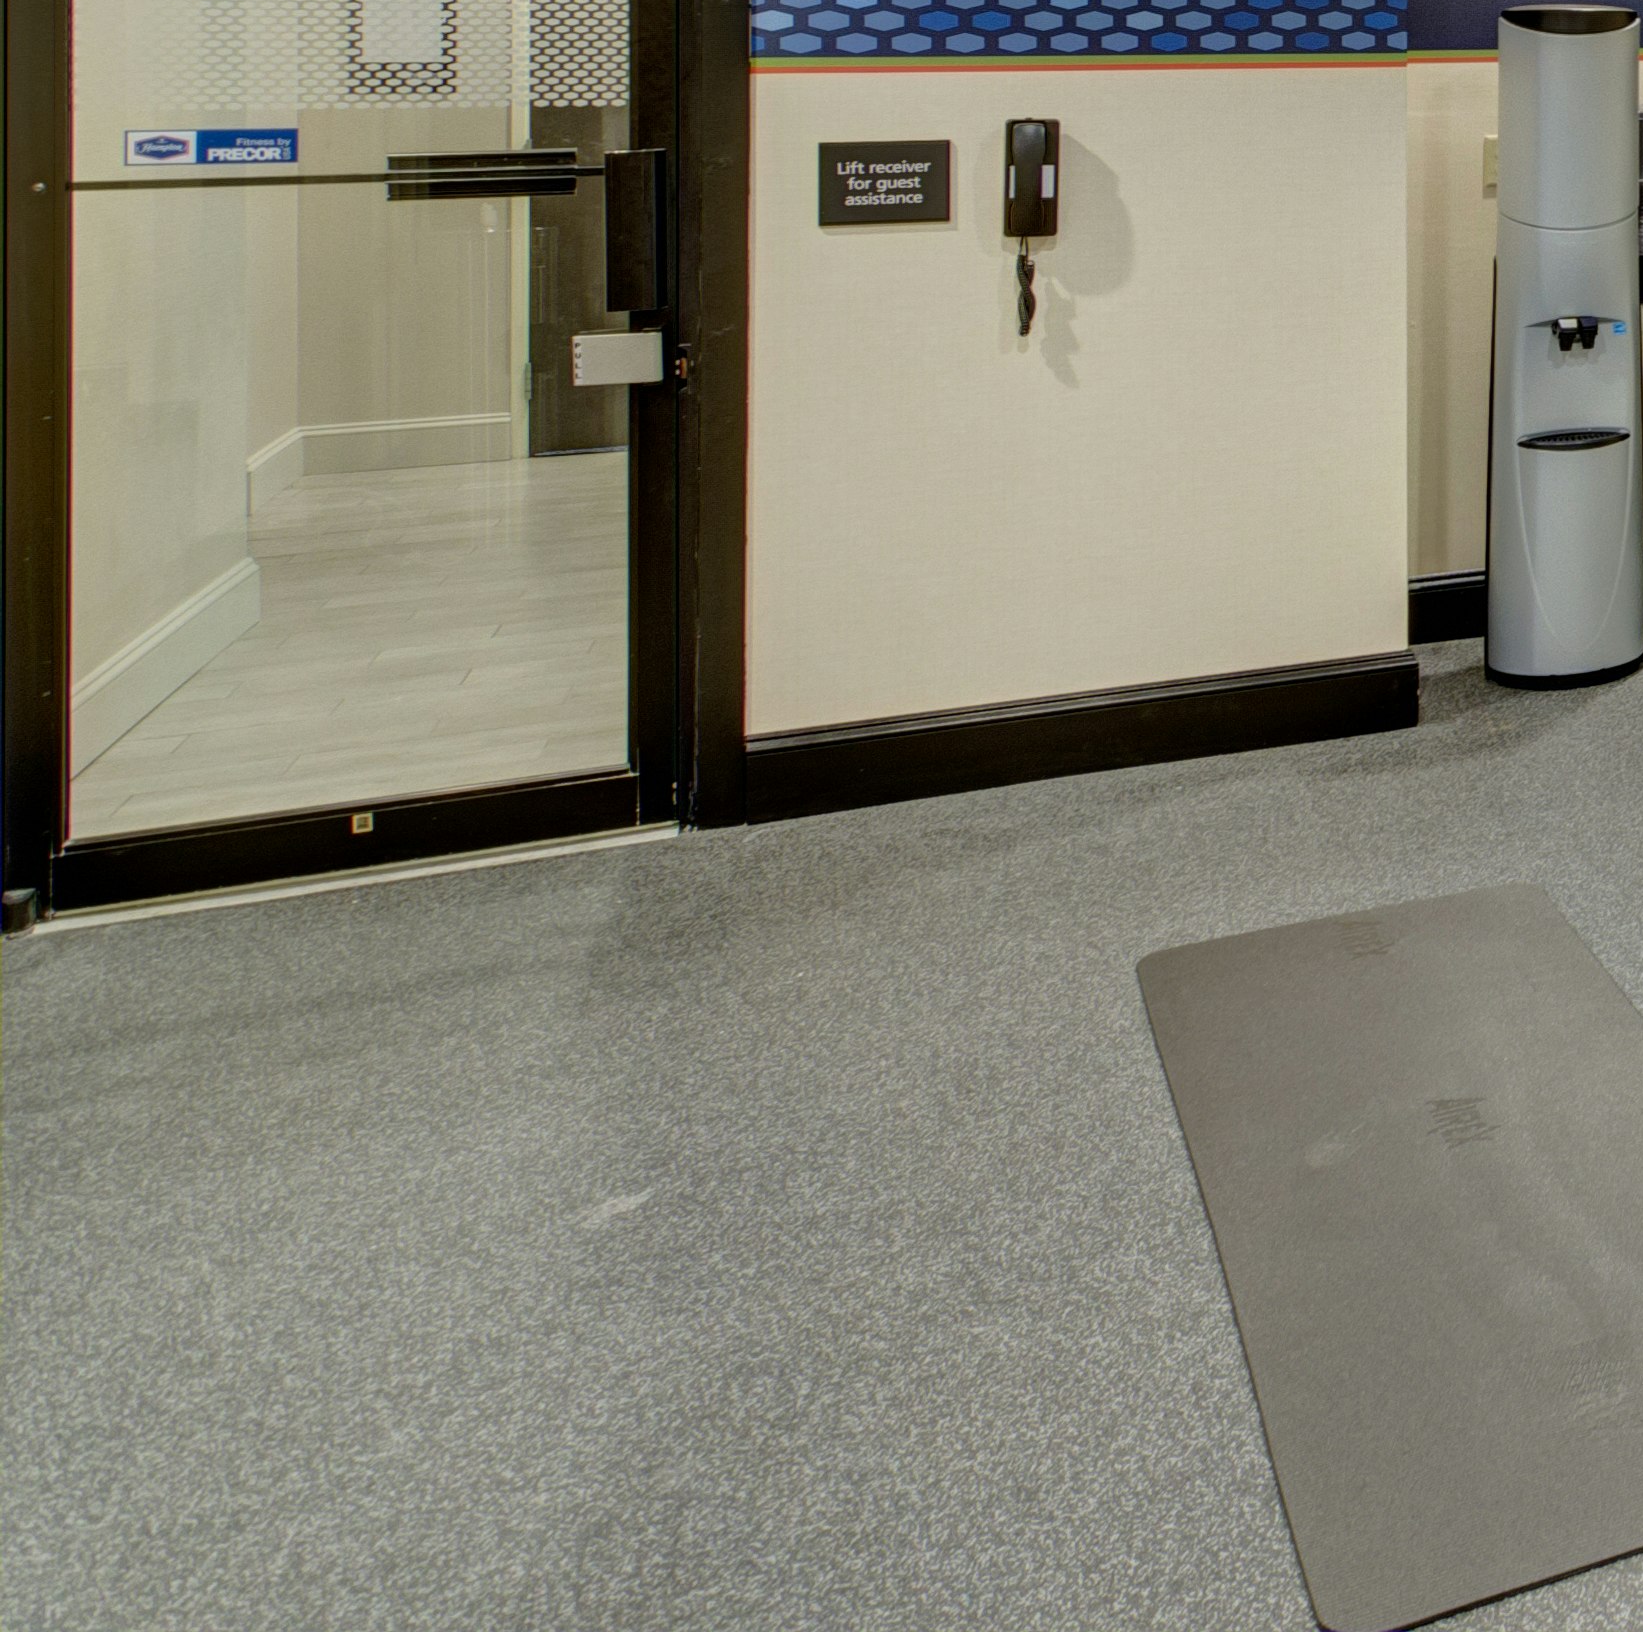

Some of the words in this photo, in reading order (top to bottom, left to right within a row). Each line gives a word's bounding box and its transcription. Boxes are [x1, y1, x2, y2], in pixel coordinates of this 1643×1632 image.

[236, 137, 274, 146] Fitness
[277, 138, 291, 147] by
[207, 147, 281, 161] PRECOR
[837, 162, 866, 175] Lift
[869, 160, 931, 174] receiver
[847, 177, 872, 190] for
[876, 177, 921, 192] guest
[844, 193, 924, 206] assistance
[574, 342, 582, 379] PULL
